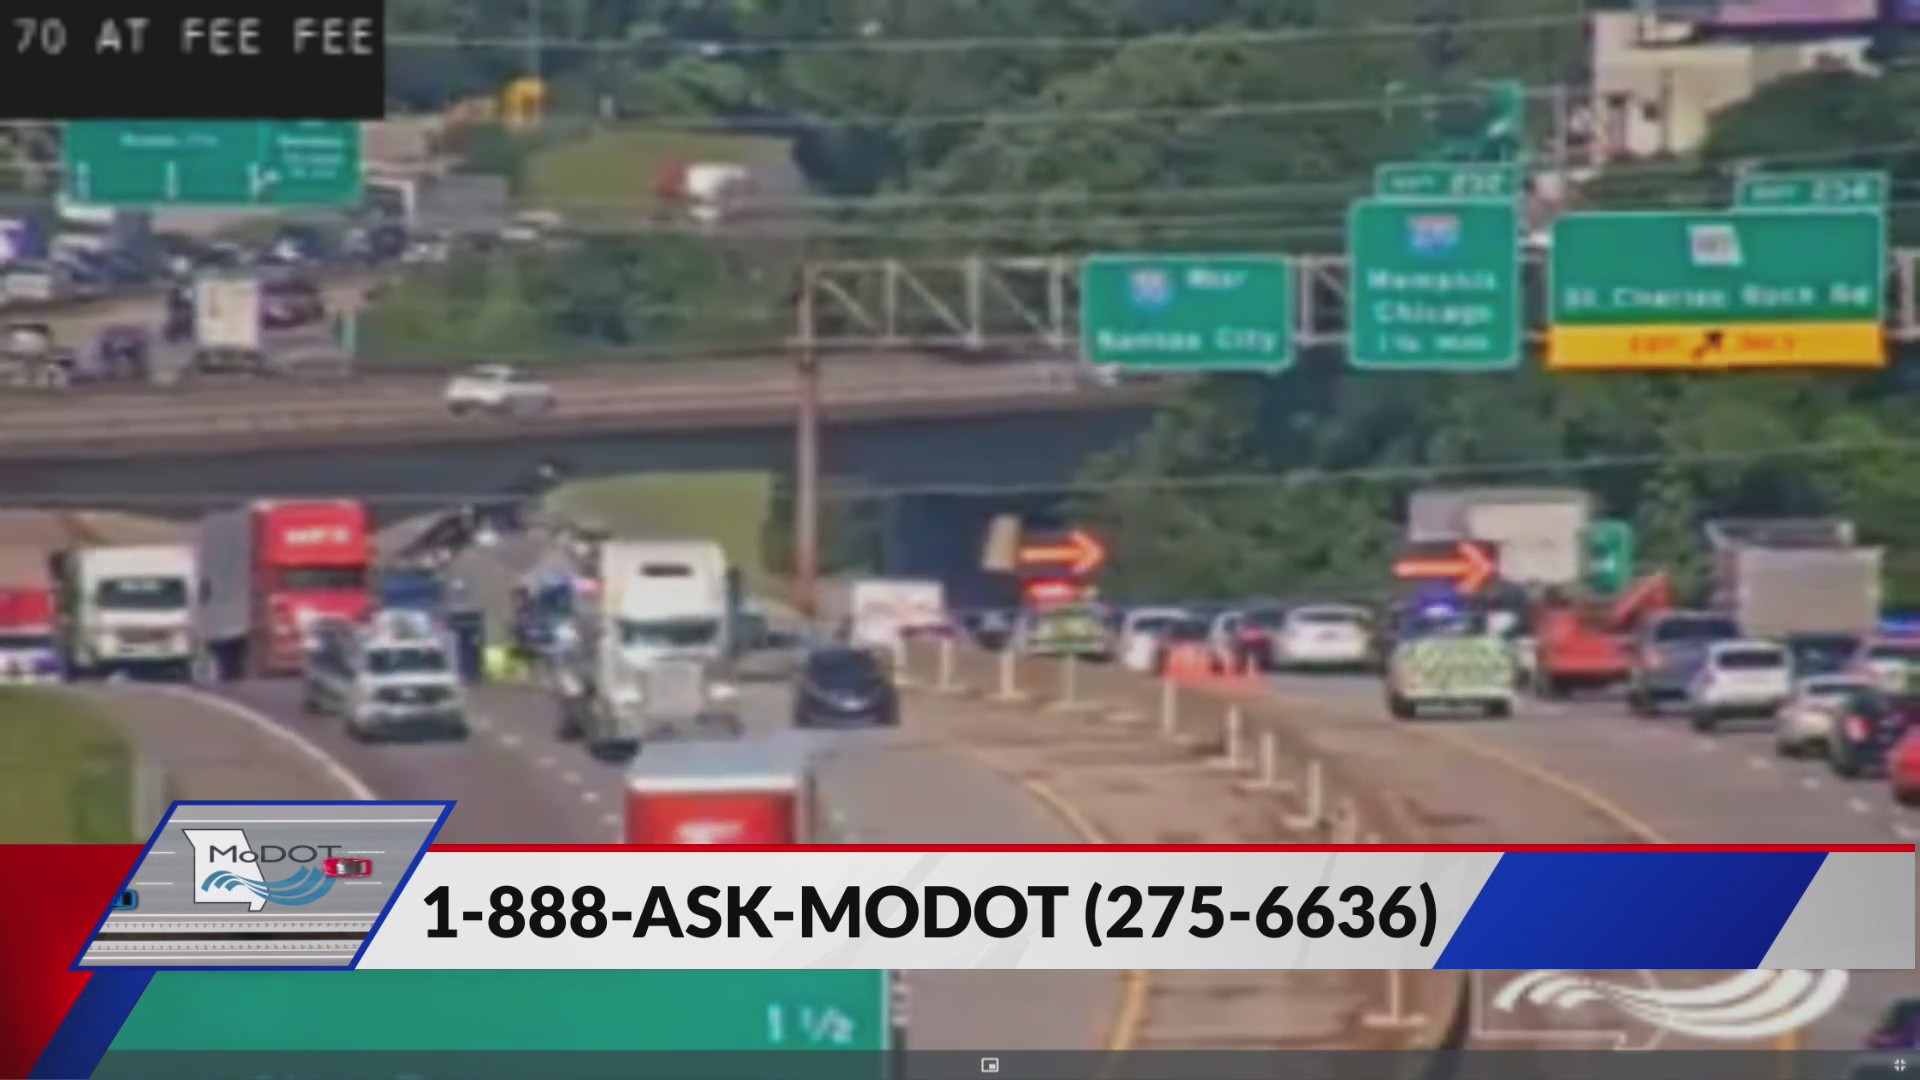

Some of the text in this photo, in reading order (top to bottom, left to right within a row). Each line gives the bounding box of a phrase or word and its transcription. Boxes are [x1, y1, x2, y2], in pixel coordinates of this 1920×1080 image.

[1373, 301, 1493, 327] Chicago
[1098, 325, 1279, 353] Kansas City
